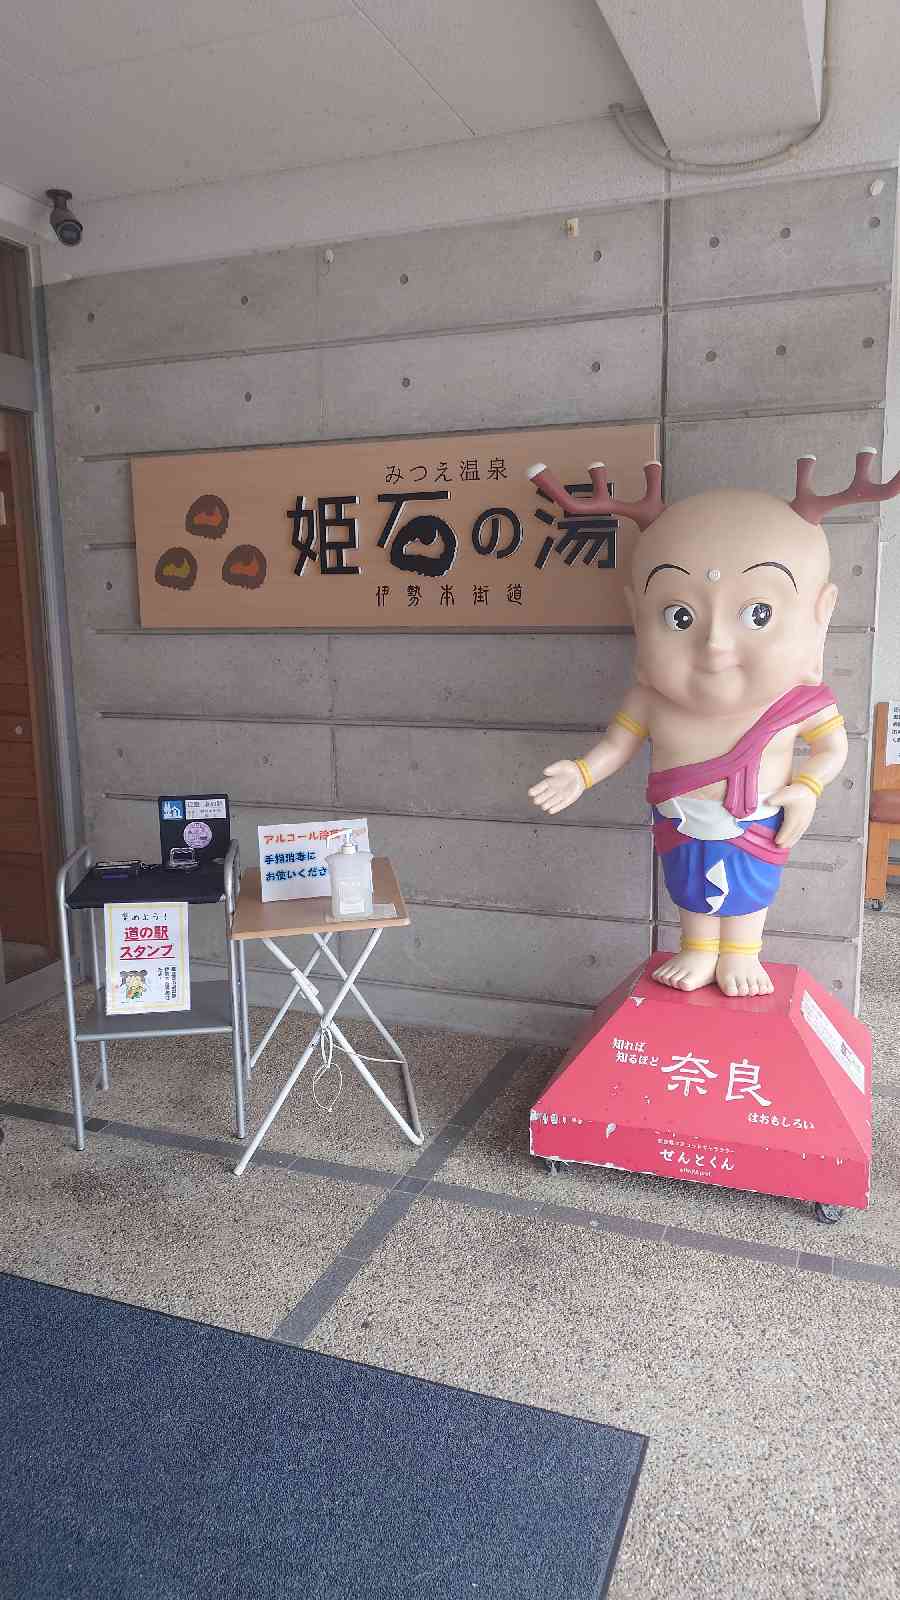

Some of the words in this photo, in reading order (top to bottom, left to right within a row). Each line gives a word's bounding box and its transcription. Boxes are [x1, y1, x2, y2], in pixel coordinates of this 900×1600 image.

[385, 457, 508, 484] みつえ温泉
[287, 481, 620, 577] 姫石の湯
[375, 583, 524, 608] 伊勢本街道
[124, 925, 169, 940] 道の駅
[120, 944, 173, 958] スタンプ
[612, 1037, 646, 1051] 知れば
[616, 1051, 660, 1067] 知るほど
[661, 1052, 772, 1107] 奈良
[747, 1112, 815, 1130] はおもしろい
[659, 1149, 735, 1171] せんとくん
